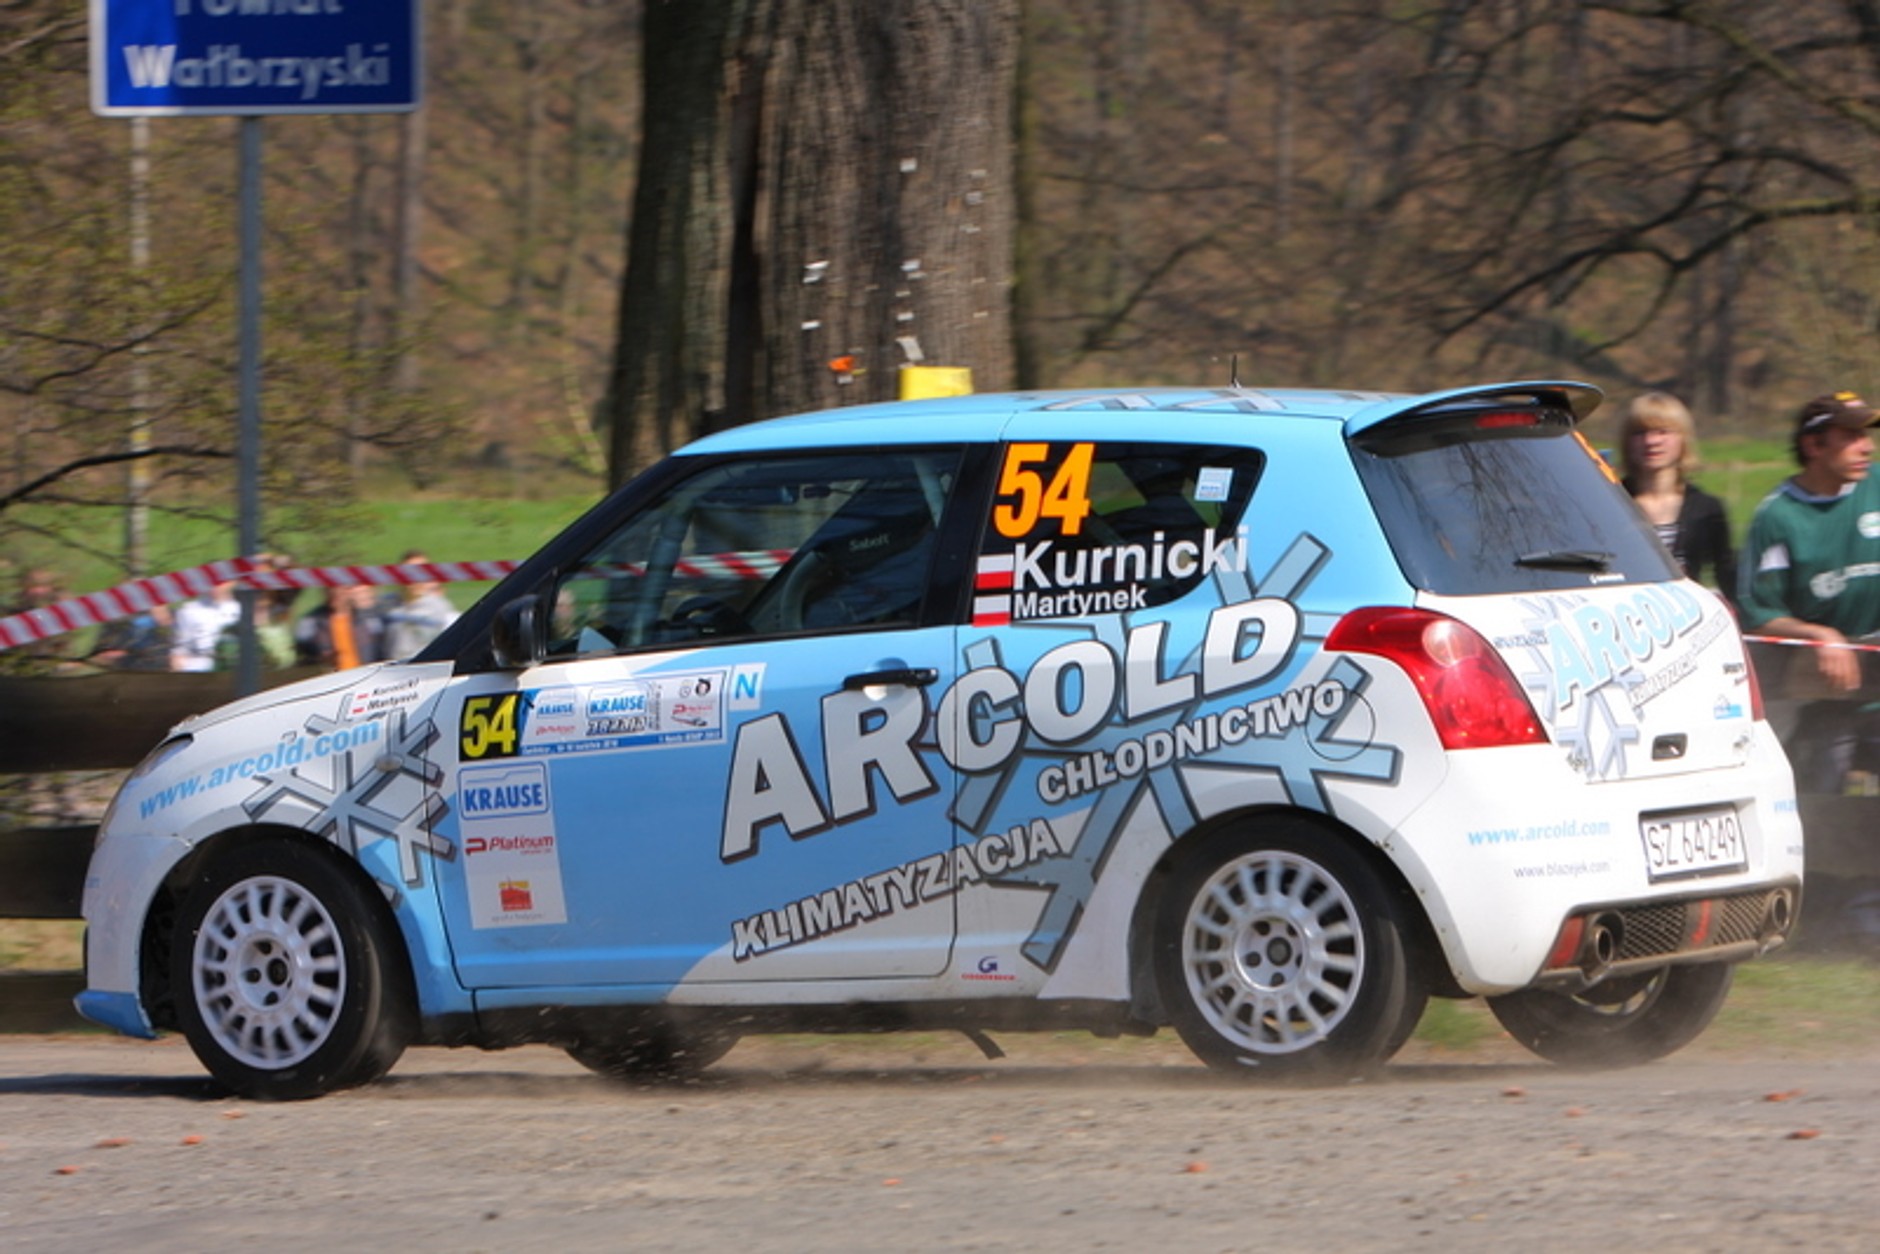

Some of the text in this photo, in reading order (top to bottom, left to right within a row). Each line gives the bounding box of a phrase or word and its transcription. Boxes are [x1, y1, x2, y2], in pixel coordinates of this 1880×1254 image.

[122, 43, 391, 101] Wałbrzyski
[993, 443, 1096, 538] 54
[1012, 525, 1249, 591] Kurnicki
[1012, 583, 1148, 620] Martynek
[1552, 582, 1704, 711] ARCOLD
[589, 694, 646, 714] KRAUSE
[735, 671, 759, 700] N
[462, 695, 519, 758] 54
[720, 598, 1303, 864] ARCOLD
[1036, 679, 1345, 805] CHŁODNICTWO
[138, 719, 382, 823] www.arcold.com
[464, 783, 544, 812] KRAUSE
[1467, 819, 1611, 846] www.arcold.com
[1648, 816, 1737, 868] SZ 64249
[731, 817, 1063, 961] KLIMATYZACJA
